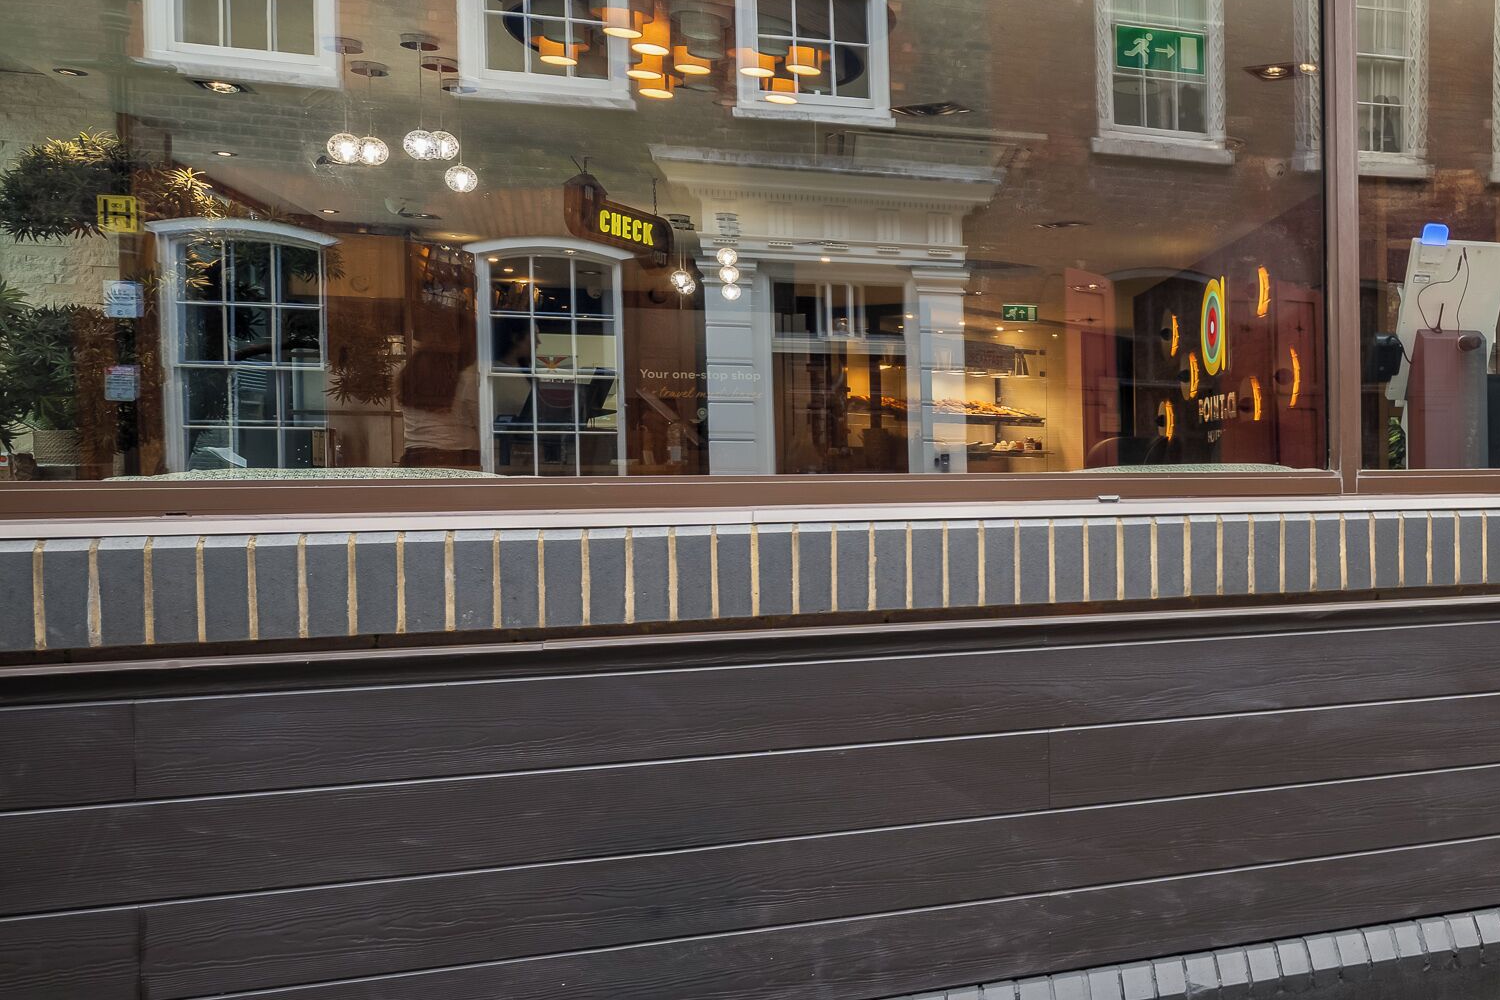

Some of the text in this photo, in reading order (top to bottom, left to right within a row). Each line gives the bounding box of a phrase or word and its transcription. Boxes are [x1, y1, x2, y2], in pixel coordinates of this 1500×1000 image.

[599, 209, 654, 246] CHECK
[640, 368, 761, 382] Your one-stop shop
